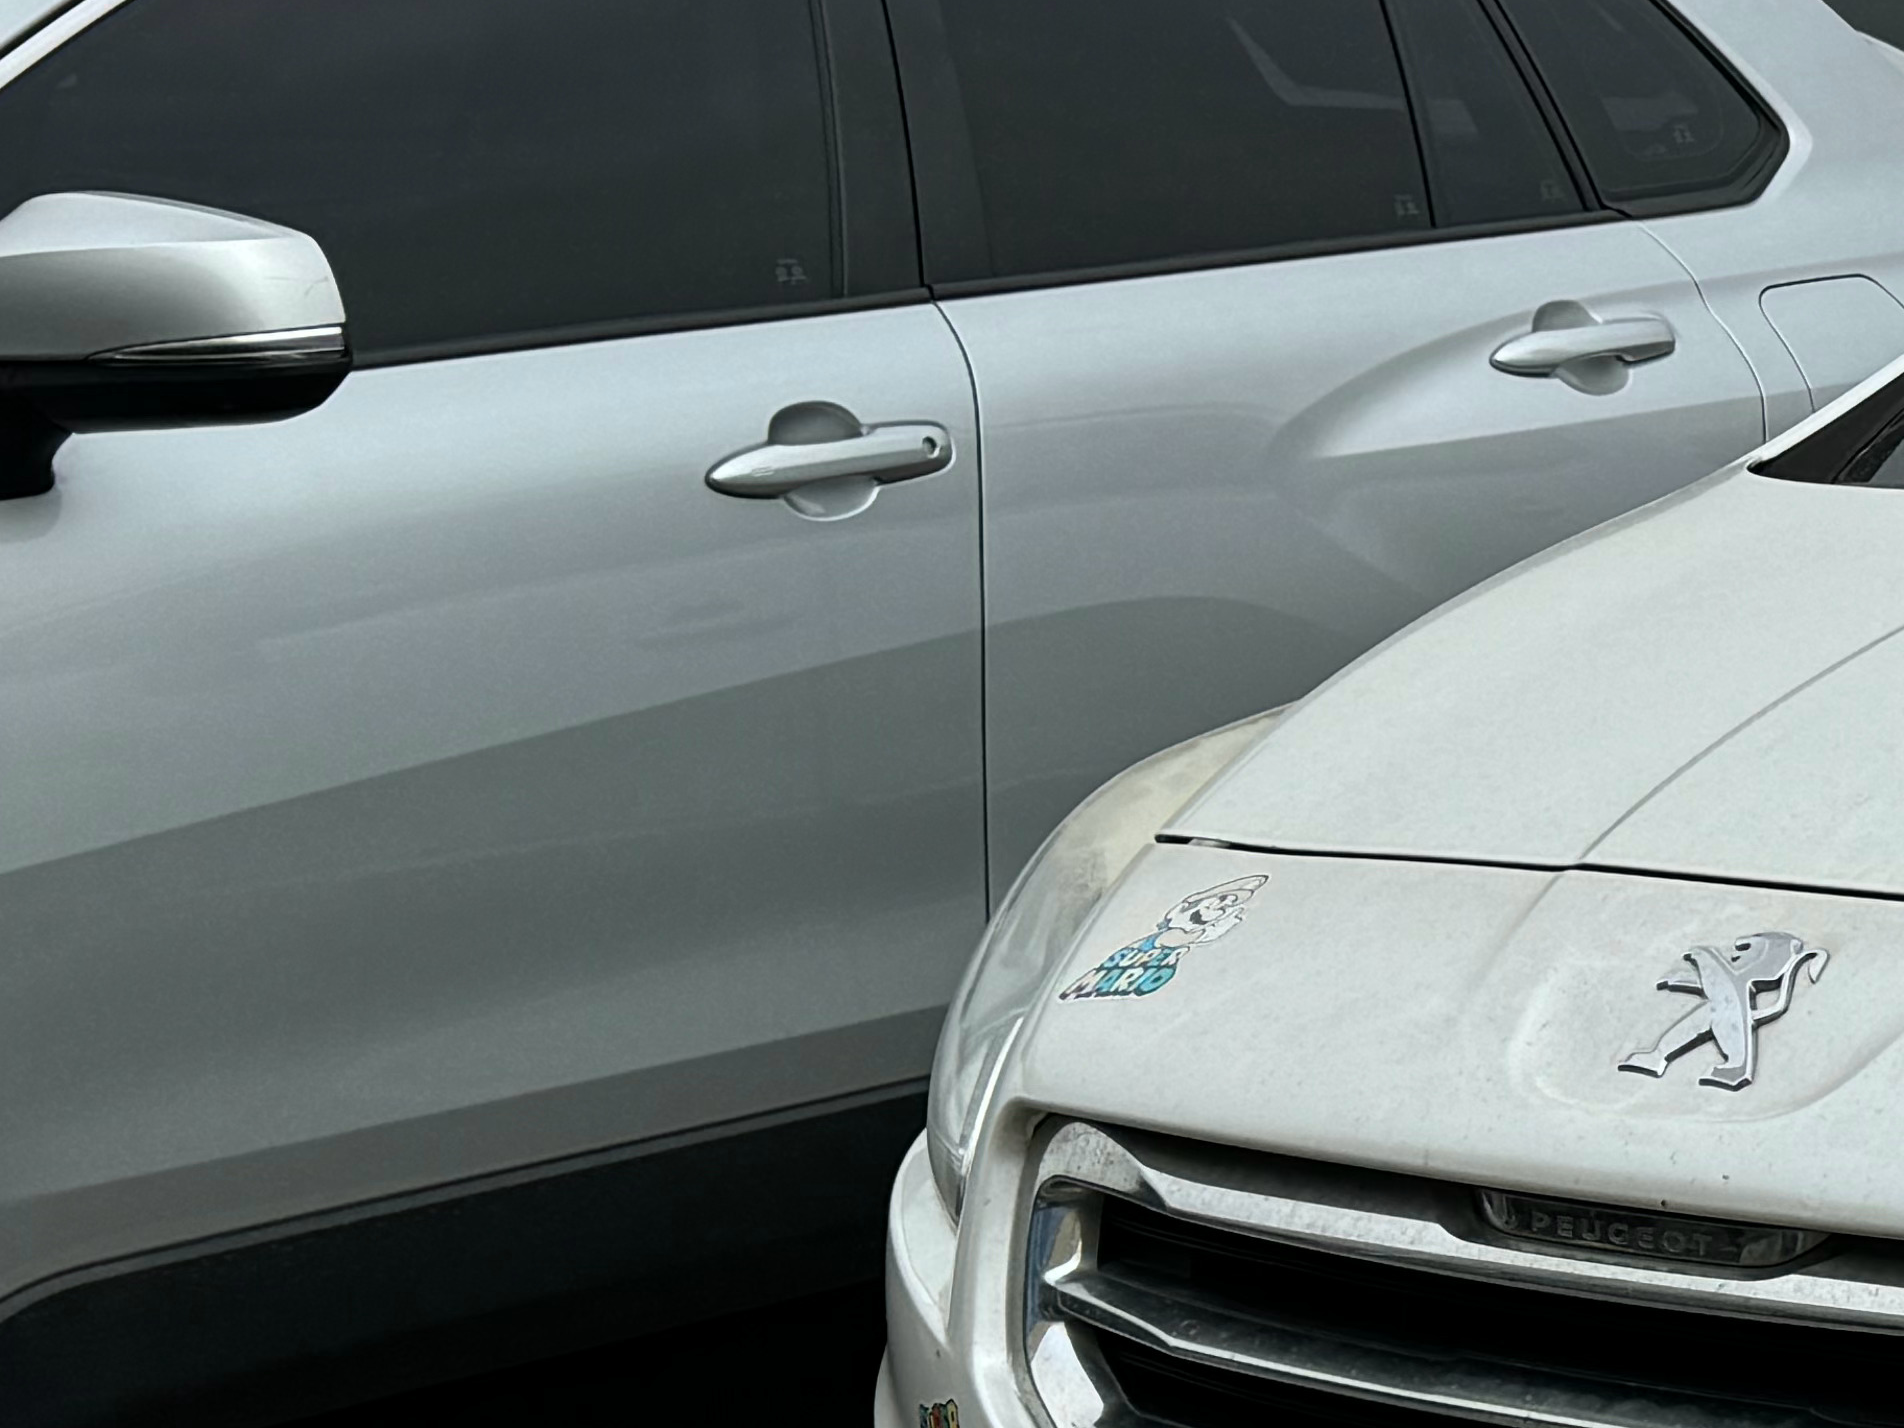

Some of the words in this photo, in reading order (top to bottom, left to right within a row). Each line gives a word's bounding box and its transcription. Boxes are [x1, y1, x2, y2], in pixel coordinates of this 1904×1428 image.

[1101, 945, 1190, 969] SUPER
[1059, 966, 1177, 1000] MARIO
[1529, 1212, 1712, 1256] PEUGEOT
